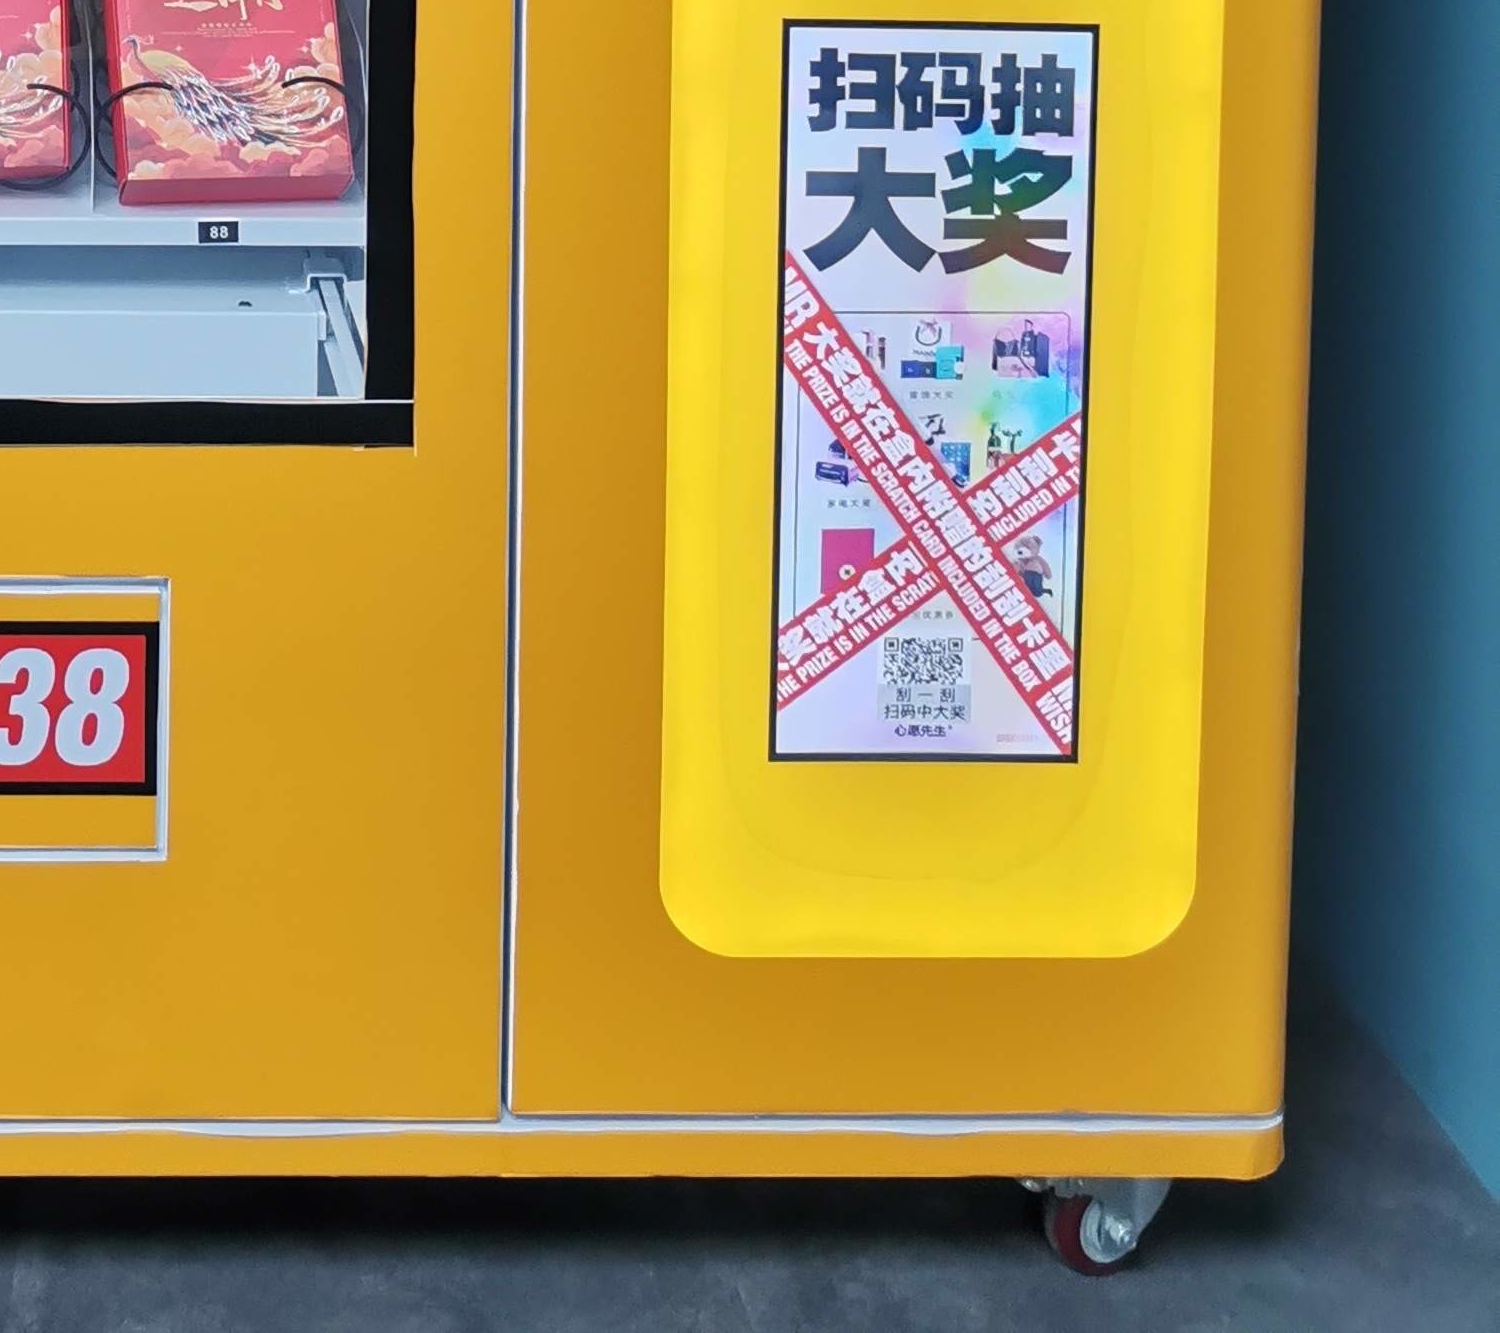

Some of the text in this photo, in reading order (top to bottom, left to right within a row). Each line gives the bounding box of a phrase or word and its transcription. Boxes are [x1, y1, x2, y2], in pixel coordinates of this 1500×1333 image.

[807, 47, 1076, 137] 扫码抽
[209, 225, 228, 239] 88
[803, 146, 1073, 275] 大奖
[784, 338, 1042, 693] THE PRIZE IS IN THE SCRATCH CARD INCLUDED IN THE BOX
[802, 321, 1071, 679] 大奖就在盒内附赠的刮刮卡里
[987, 488, 1054, 542] INCLUDED
[1050, 475, 1072, 497] IN
[777, 541, 928, 671] 奖就在盒内
[795, 646, 839, 683] PRIZE
[833, 635, 854, 655] IS
[848, 622, 870, 644] IN
[863, 603, 896, 631] THE
[891, 571, 939, 612] SCRAT
[884, 704, 965, 721] 扫码中大奖
[894, 725, 947, 737] 心愿先生
[896, 688, 956, 702] 刮一刮
